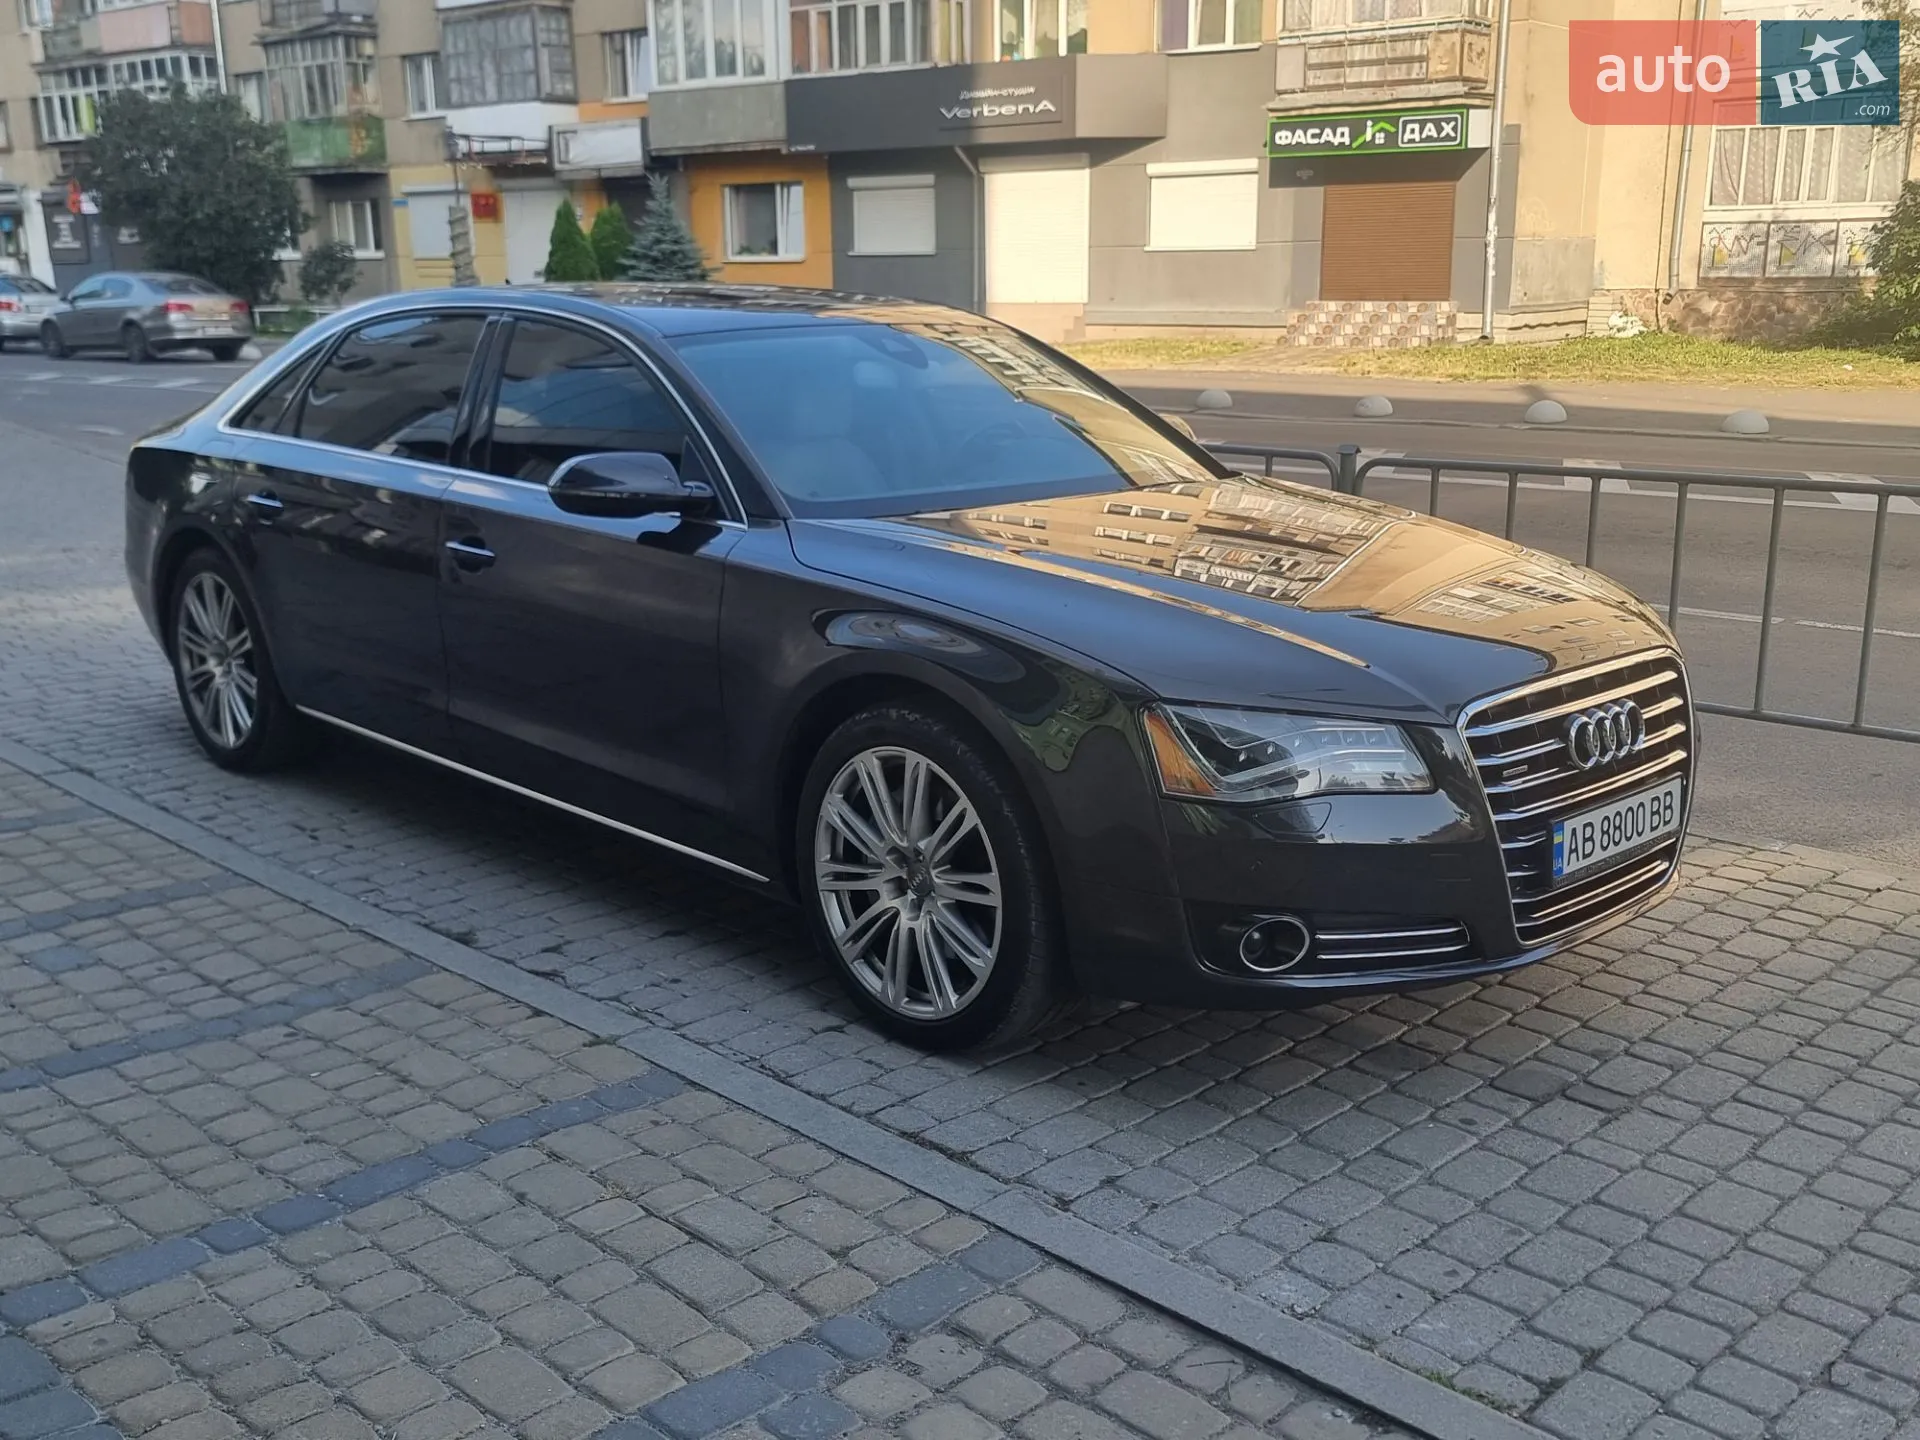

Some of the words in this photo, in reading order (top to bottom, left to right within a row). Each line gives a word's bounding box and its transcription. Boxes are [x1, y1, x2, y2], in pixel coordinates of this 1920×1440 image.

[1274, 126, 1350, 146] ФАСАД
[1403, 121, 1456, 143] ДАХ
[1567, 821, 1595, 867] AB
[1600, 801, 1646, 851] 8800
[1650, 790, 1674, 832] BB
